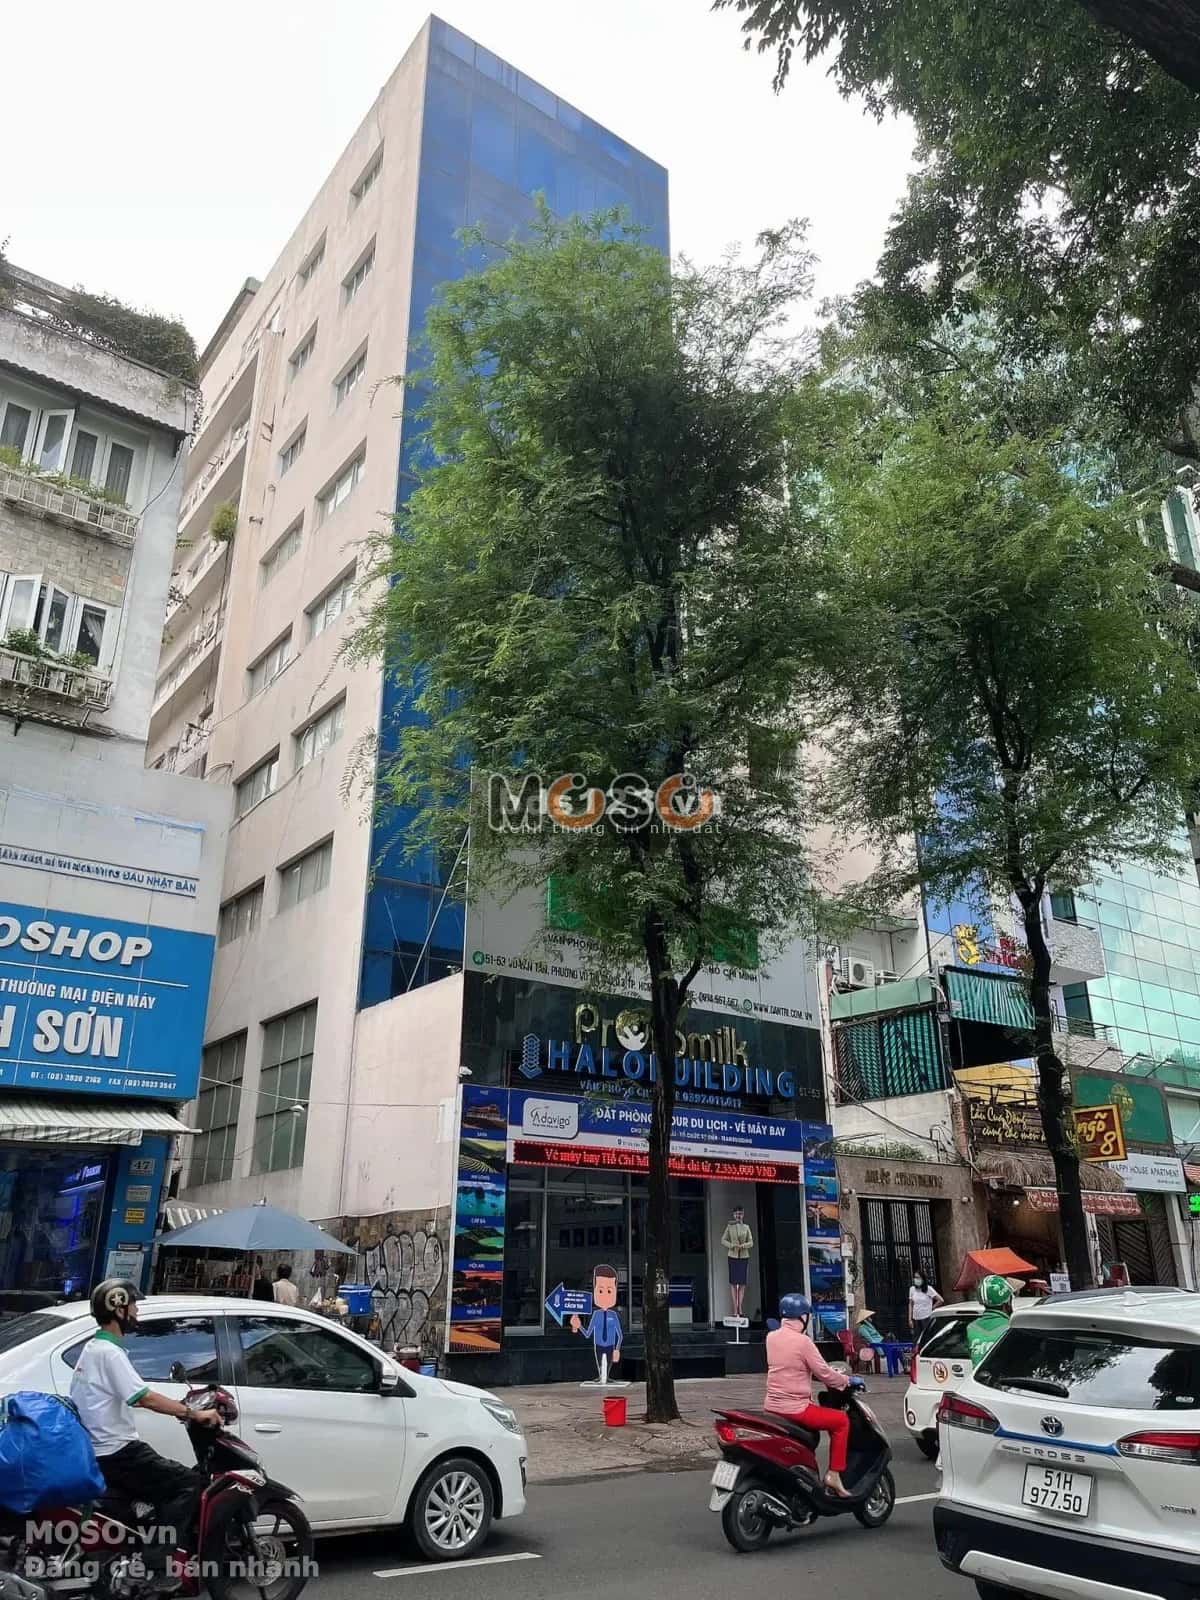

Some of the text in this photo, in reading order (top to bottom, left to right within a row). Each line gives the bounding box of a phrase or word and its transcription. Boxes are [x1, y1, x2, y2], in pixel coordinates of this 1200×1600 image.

[650, 1052, 796, 1098] UILDING
[1100, 1131, 1116, 1155] 8
[1044, 1470, 1073, 1491] 51H
[1030, 1487, 1082, 1513] 977.50
